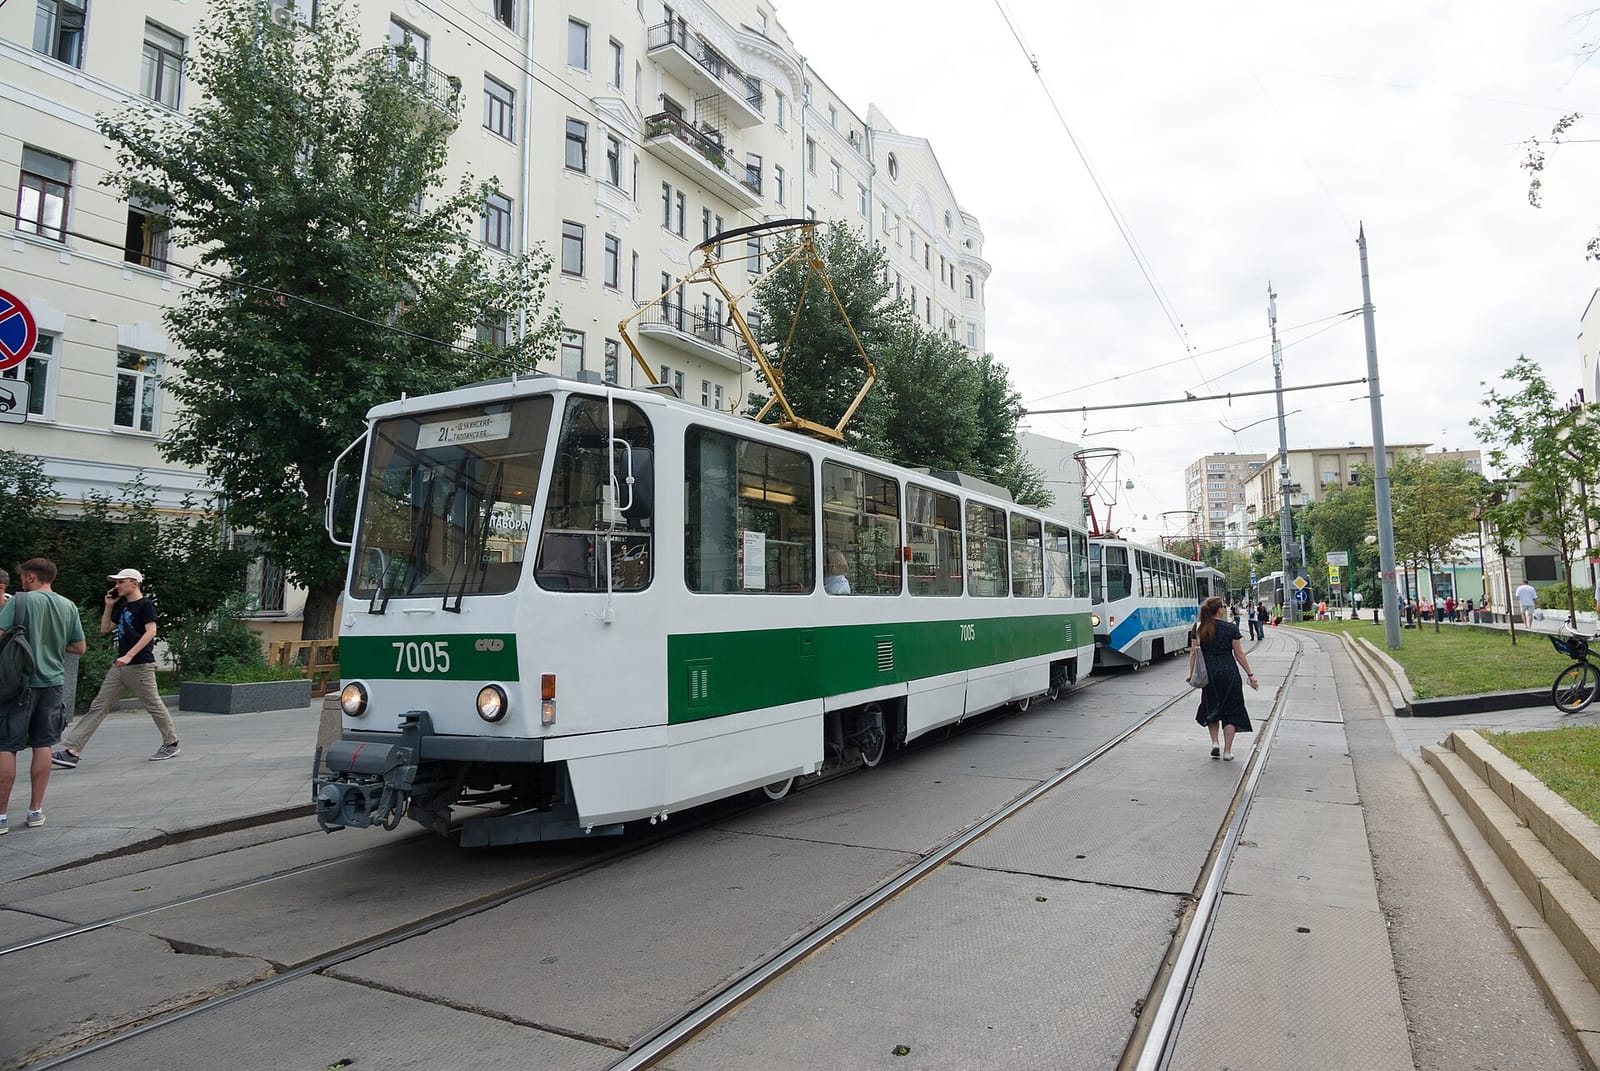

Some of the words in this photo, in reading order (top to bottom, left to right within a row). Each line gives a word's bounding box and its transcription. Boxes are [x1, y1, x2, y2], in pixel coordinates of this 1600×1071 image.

[438, 427, 449, 441] 21
[960, 623, 975, 641] 7005
[392, 641, 450, 673] 7005
